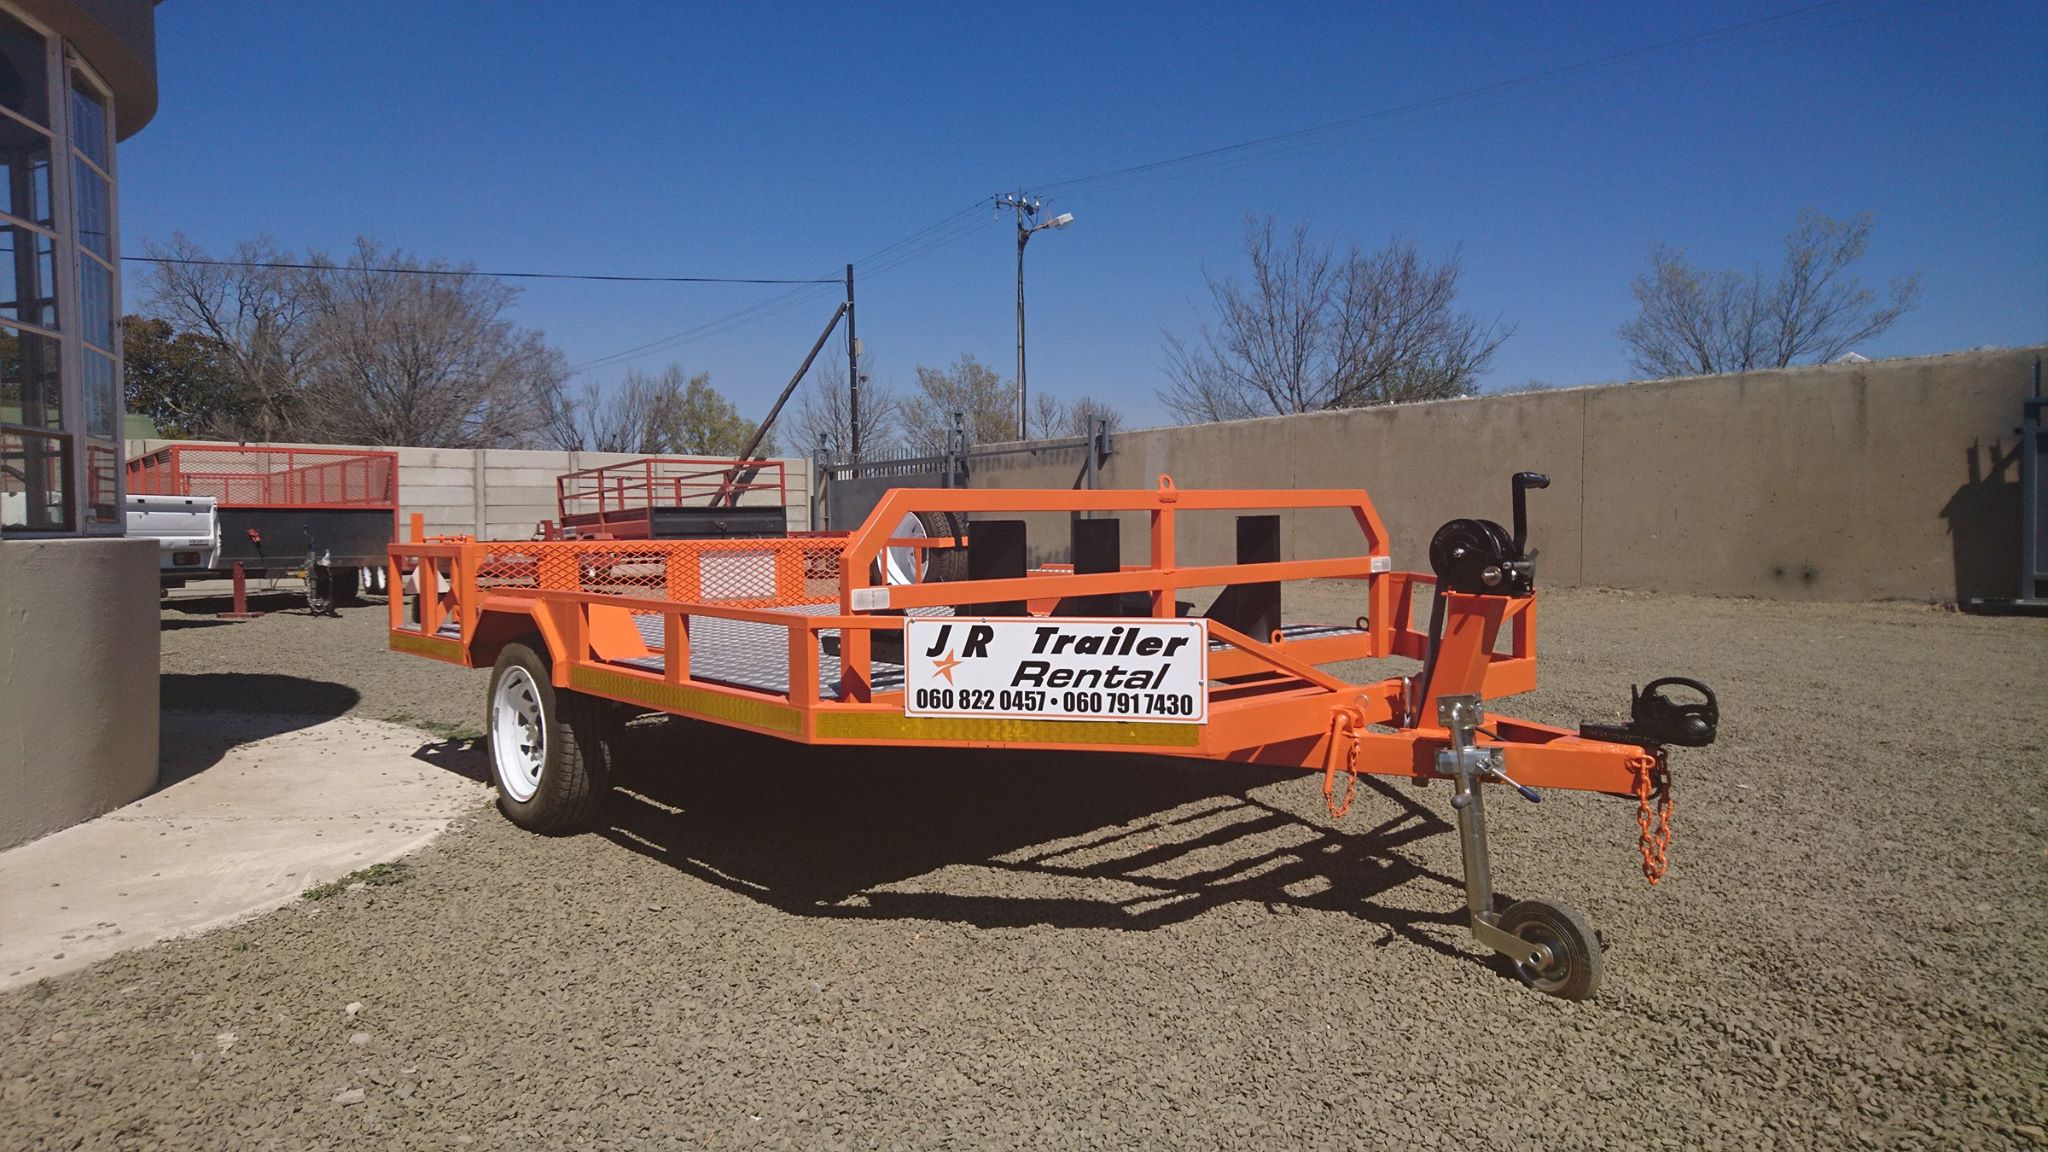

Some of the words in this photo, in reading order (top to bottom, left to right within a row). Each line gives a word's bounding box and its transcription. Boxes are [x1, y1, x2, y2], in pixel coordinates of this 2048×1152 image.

[1032, 626, 1189, 658] Trailer
[1011, 661, 1171, 690] Rental
[916, 689, 953, 709] 060
[958, 690, 994, 710] 822
[1000, 690, 1045, 711] 0457
[1063, 692, 1101, 712] 060
[1107, 692, 1138, 713] 791
[1143, 694, 1192, 716] 7430
